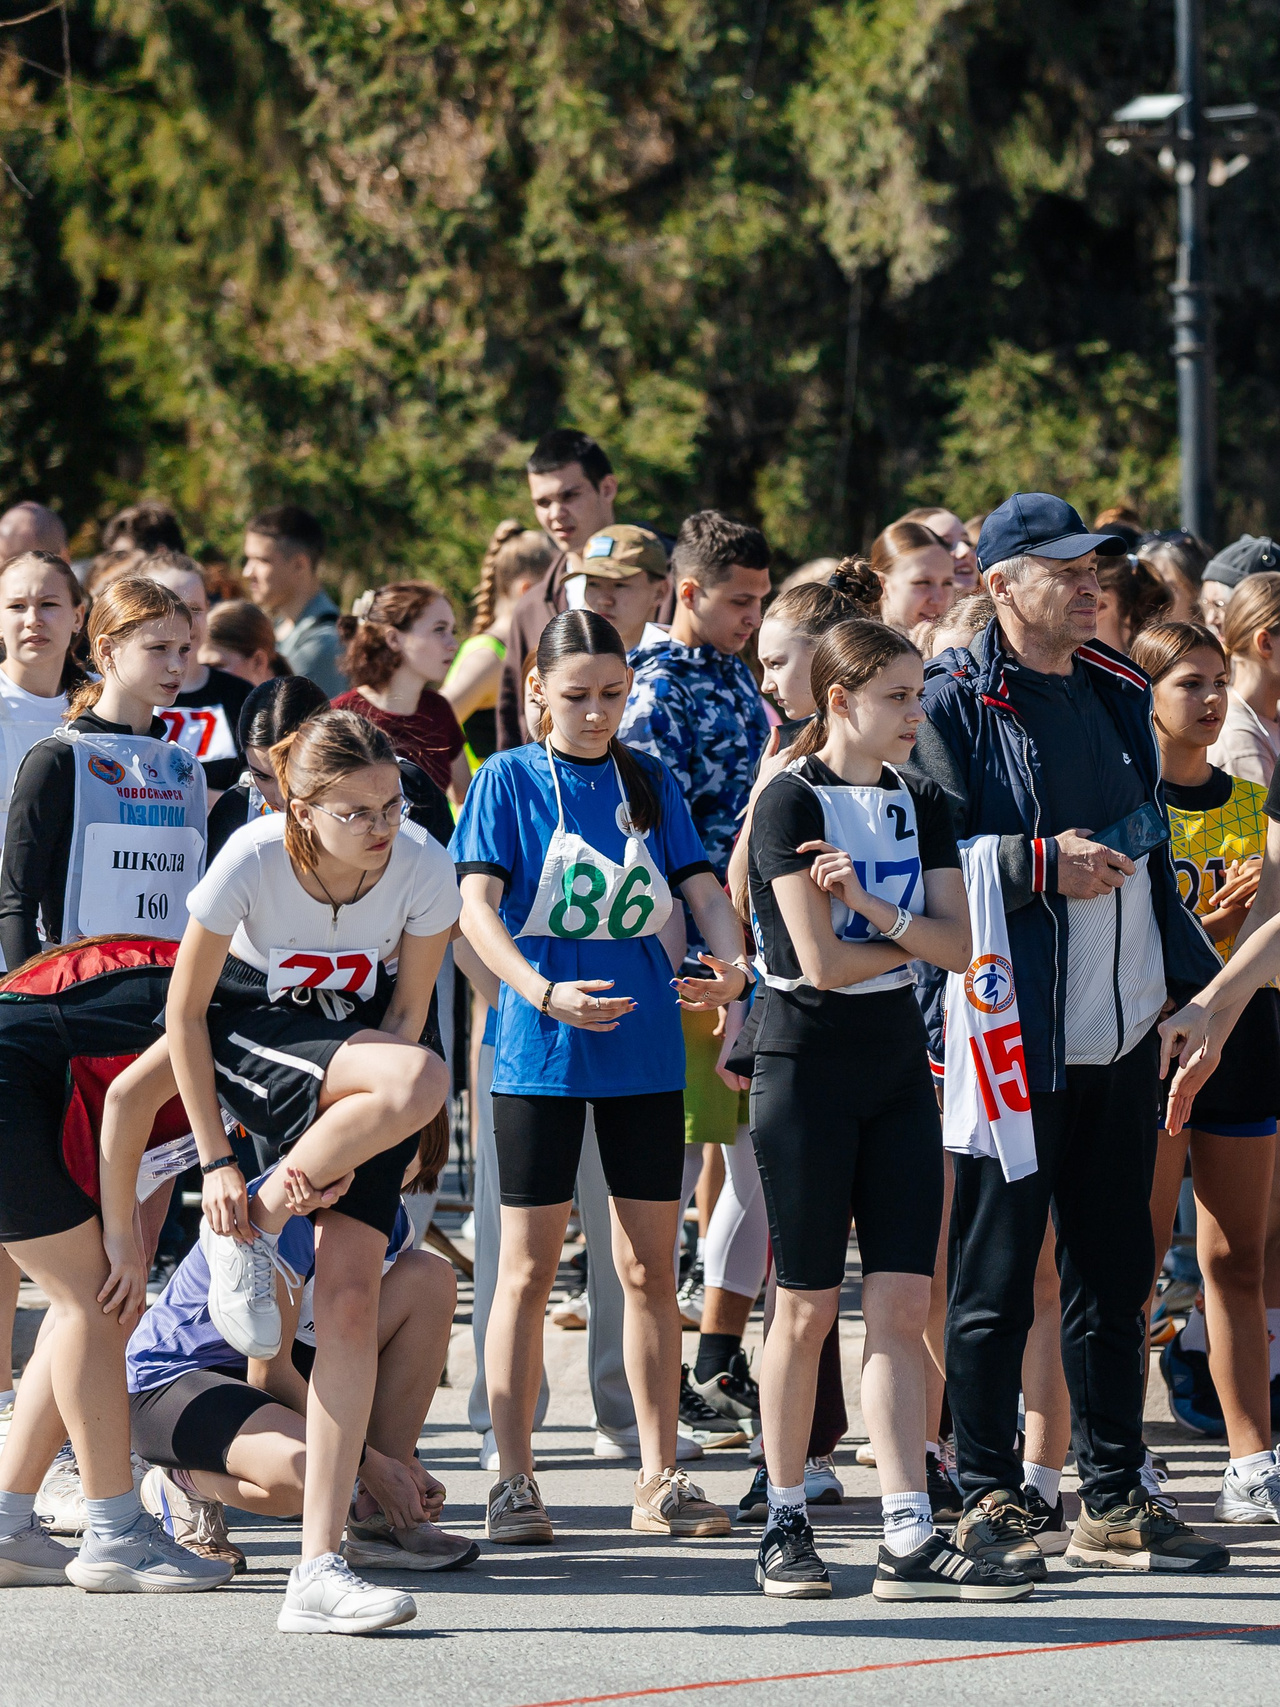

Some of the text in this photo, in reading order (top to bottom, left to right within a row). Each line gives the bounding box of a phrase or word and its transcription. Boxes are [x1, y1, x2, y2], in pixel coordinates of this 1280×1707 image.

[886, 803, 916, 842] 2
[135, 893, 169, 920] 160
[548, 862, 655, 940] 86
[841, 857, 921, 939] 17
